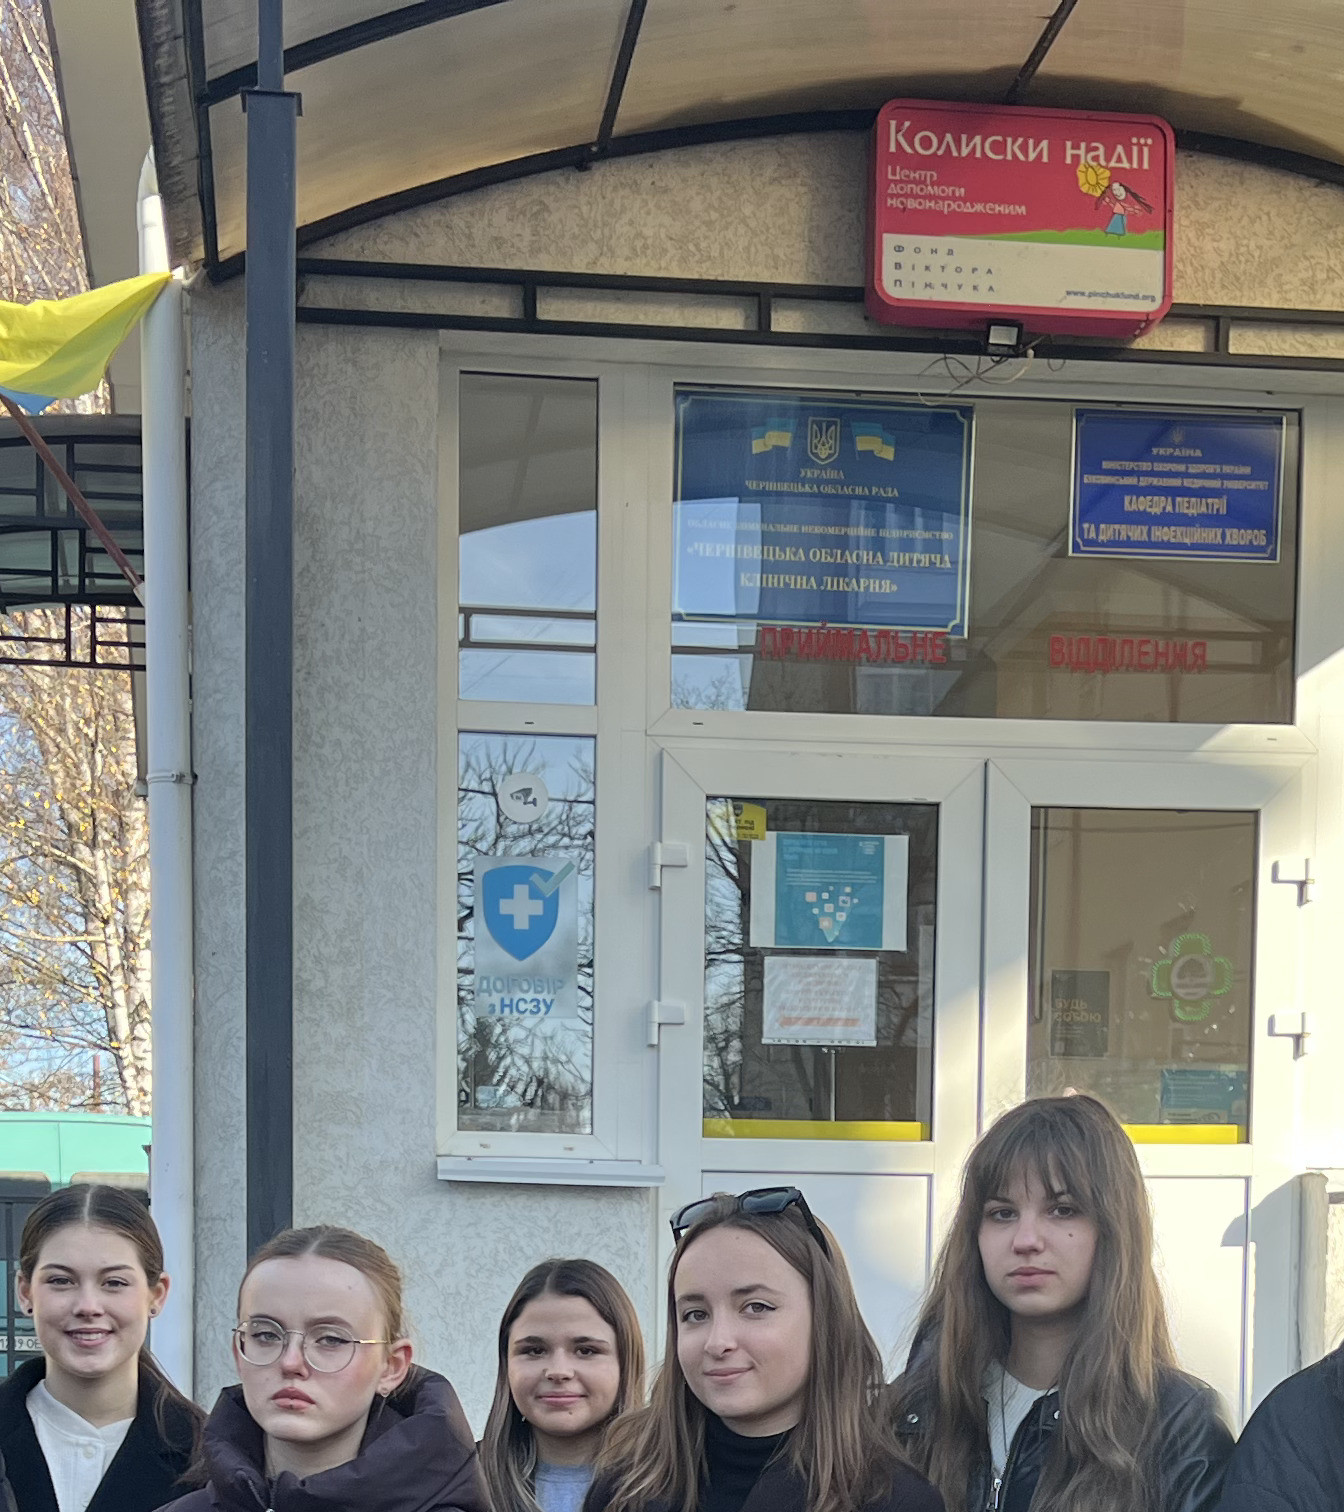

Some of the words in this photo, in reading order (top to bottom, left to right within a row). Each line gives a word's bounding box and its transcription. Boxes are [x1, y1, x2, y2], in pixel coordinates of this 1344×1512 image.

[887, 119, 1049, 163] Колиски
[1065, 136, 1152, 170] надії
[887, 165, 937, 184] Центр
[887, 183, 965, 198] допомоги
[887, 197, 1027, 216] новонародженим
[800, 468, 844, 480] УКРАЇНА
[871, 486, 899, 497] РАДА
[1124, 495, 1173, 515] КАФЕДРА
[1175, 495, 1227, 517] ПЕДІАТРІЇ
[1083, 523, 1096, 539] ТА
[1098, 523, 1148, 543] ДИТЯЧИХ
[1151, 524, 1223, 546] ІНФЕКЦІЙНИХ
[1225, 528, 1267, 546] ХВОРОБ
[809, 547, 884, 566] ОБЛАСНА
[886, 551, 952, 569] ДИТЯЧА
[740, 571, 817, 590] КЛІНІЧНА
[761, 621, 948, 664] ПРИЙМАЛЬНЕ
[1050, 636, 1208, 673] ВІДДІЛЕННЯ
[477, 976, 566, 997] ДОГОВІР
[500, 997, 555, 1015] НСЗУ
